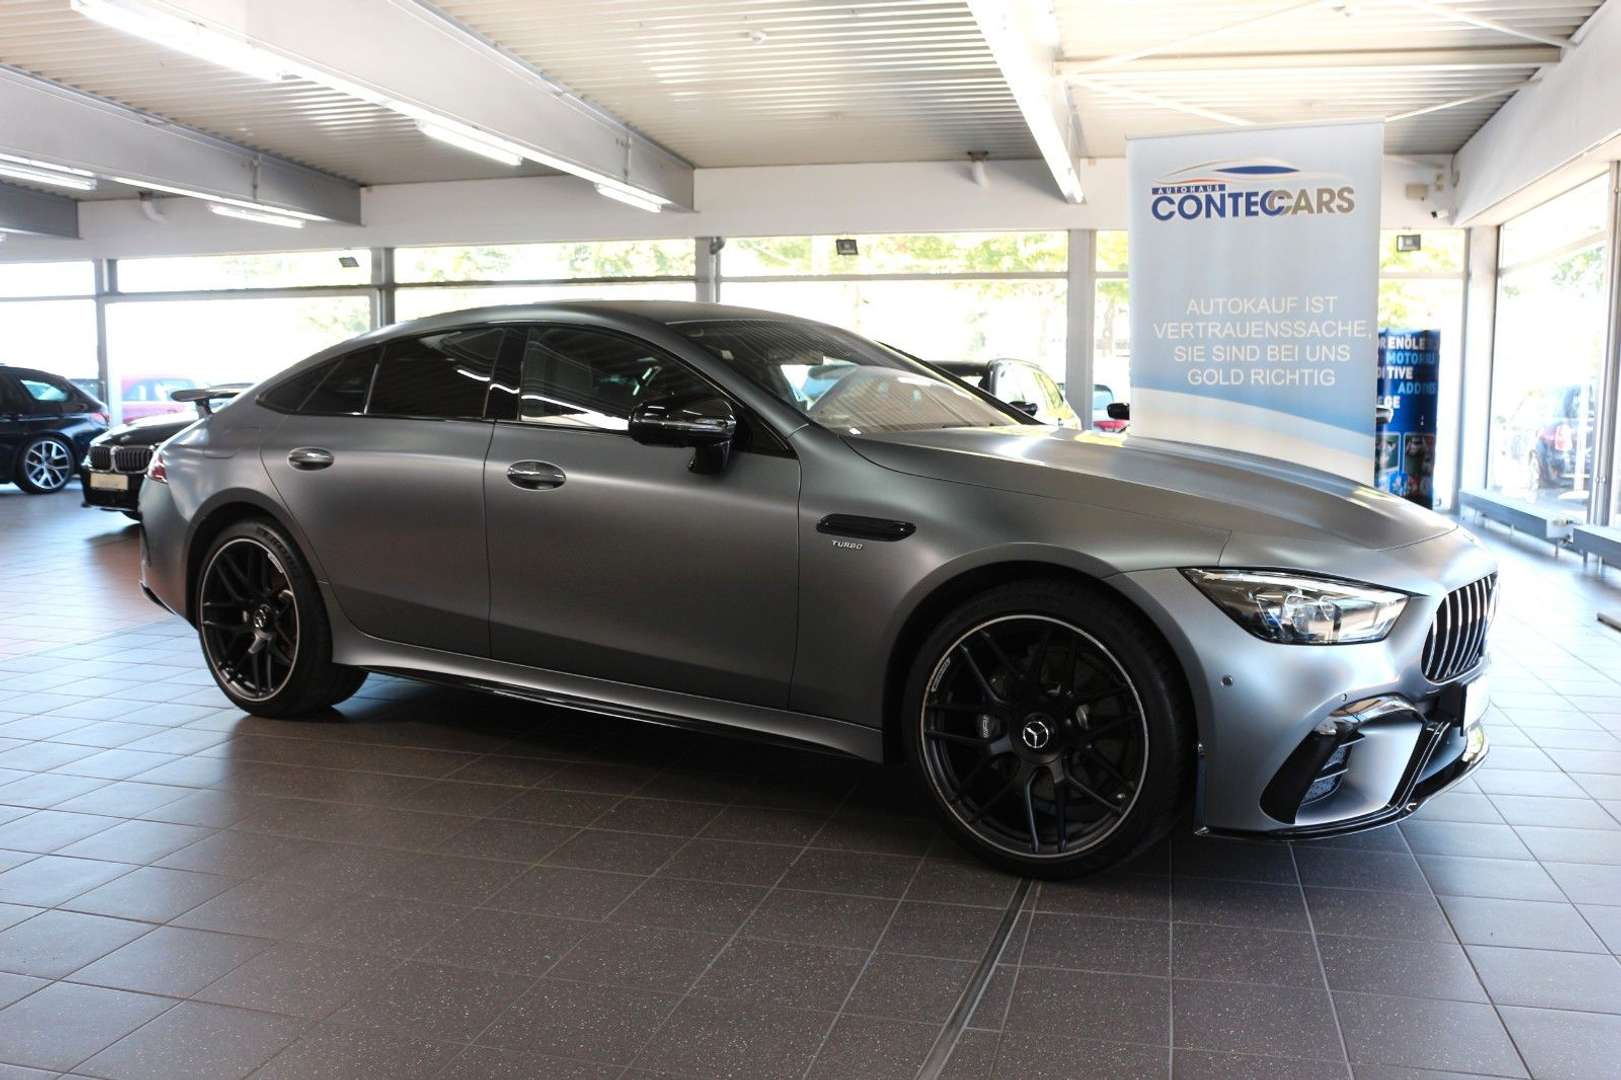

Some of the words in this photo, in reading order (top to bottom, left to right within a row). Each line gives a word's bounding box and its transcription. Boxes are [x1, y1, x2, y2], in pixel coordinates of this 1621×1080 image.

[1157, 185, 1221, 195] AUTOHAUS
[1186, 297, 1297, 315] AUTOKAUF
[1305, 296, 1338, 313] IST
[1153, 320, 1373, 339] VERTRAUENSSACHE,
[1174, 346, 1206, 362] SIE
[1212, 345, 1260, 362] SIND
[1267, 345, 1299, 361] BEI
[1306, 345, 1350, 362] UNS
[1187, 369, 1244, 386] GOLD
[1251, 368, 1336, 385] RICHTIG
[832, 540, 863, 550] TURBO
